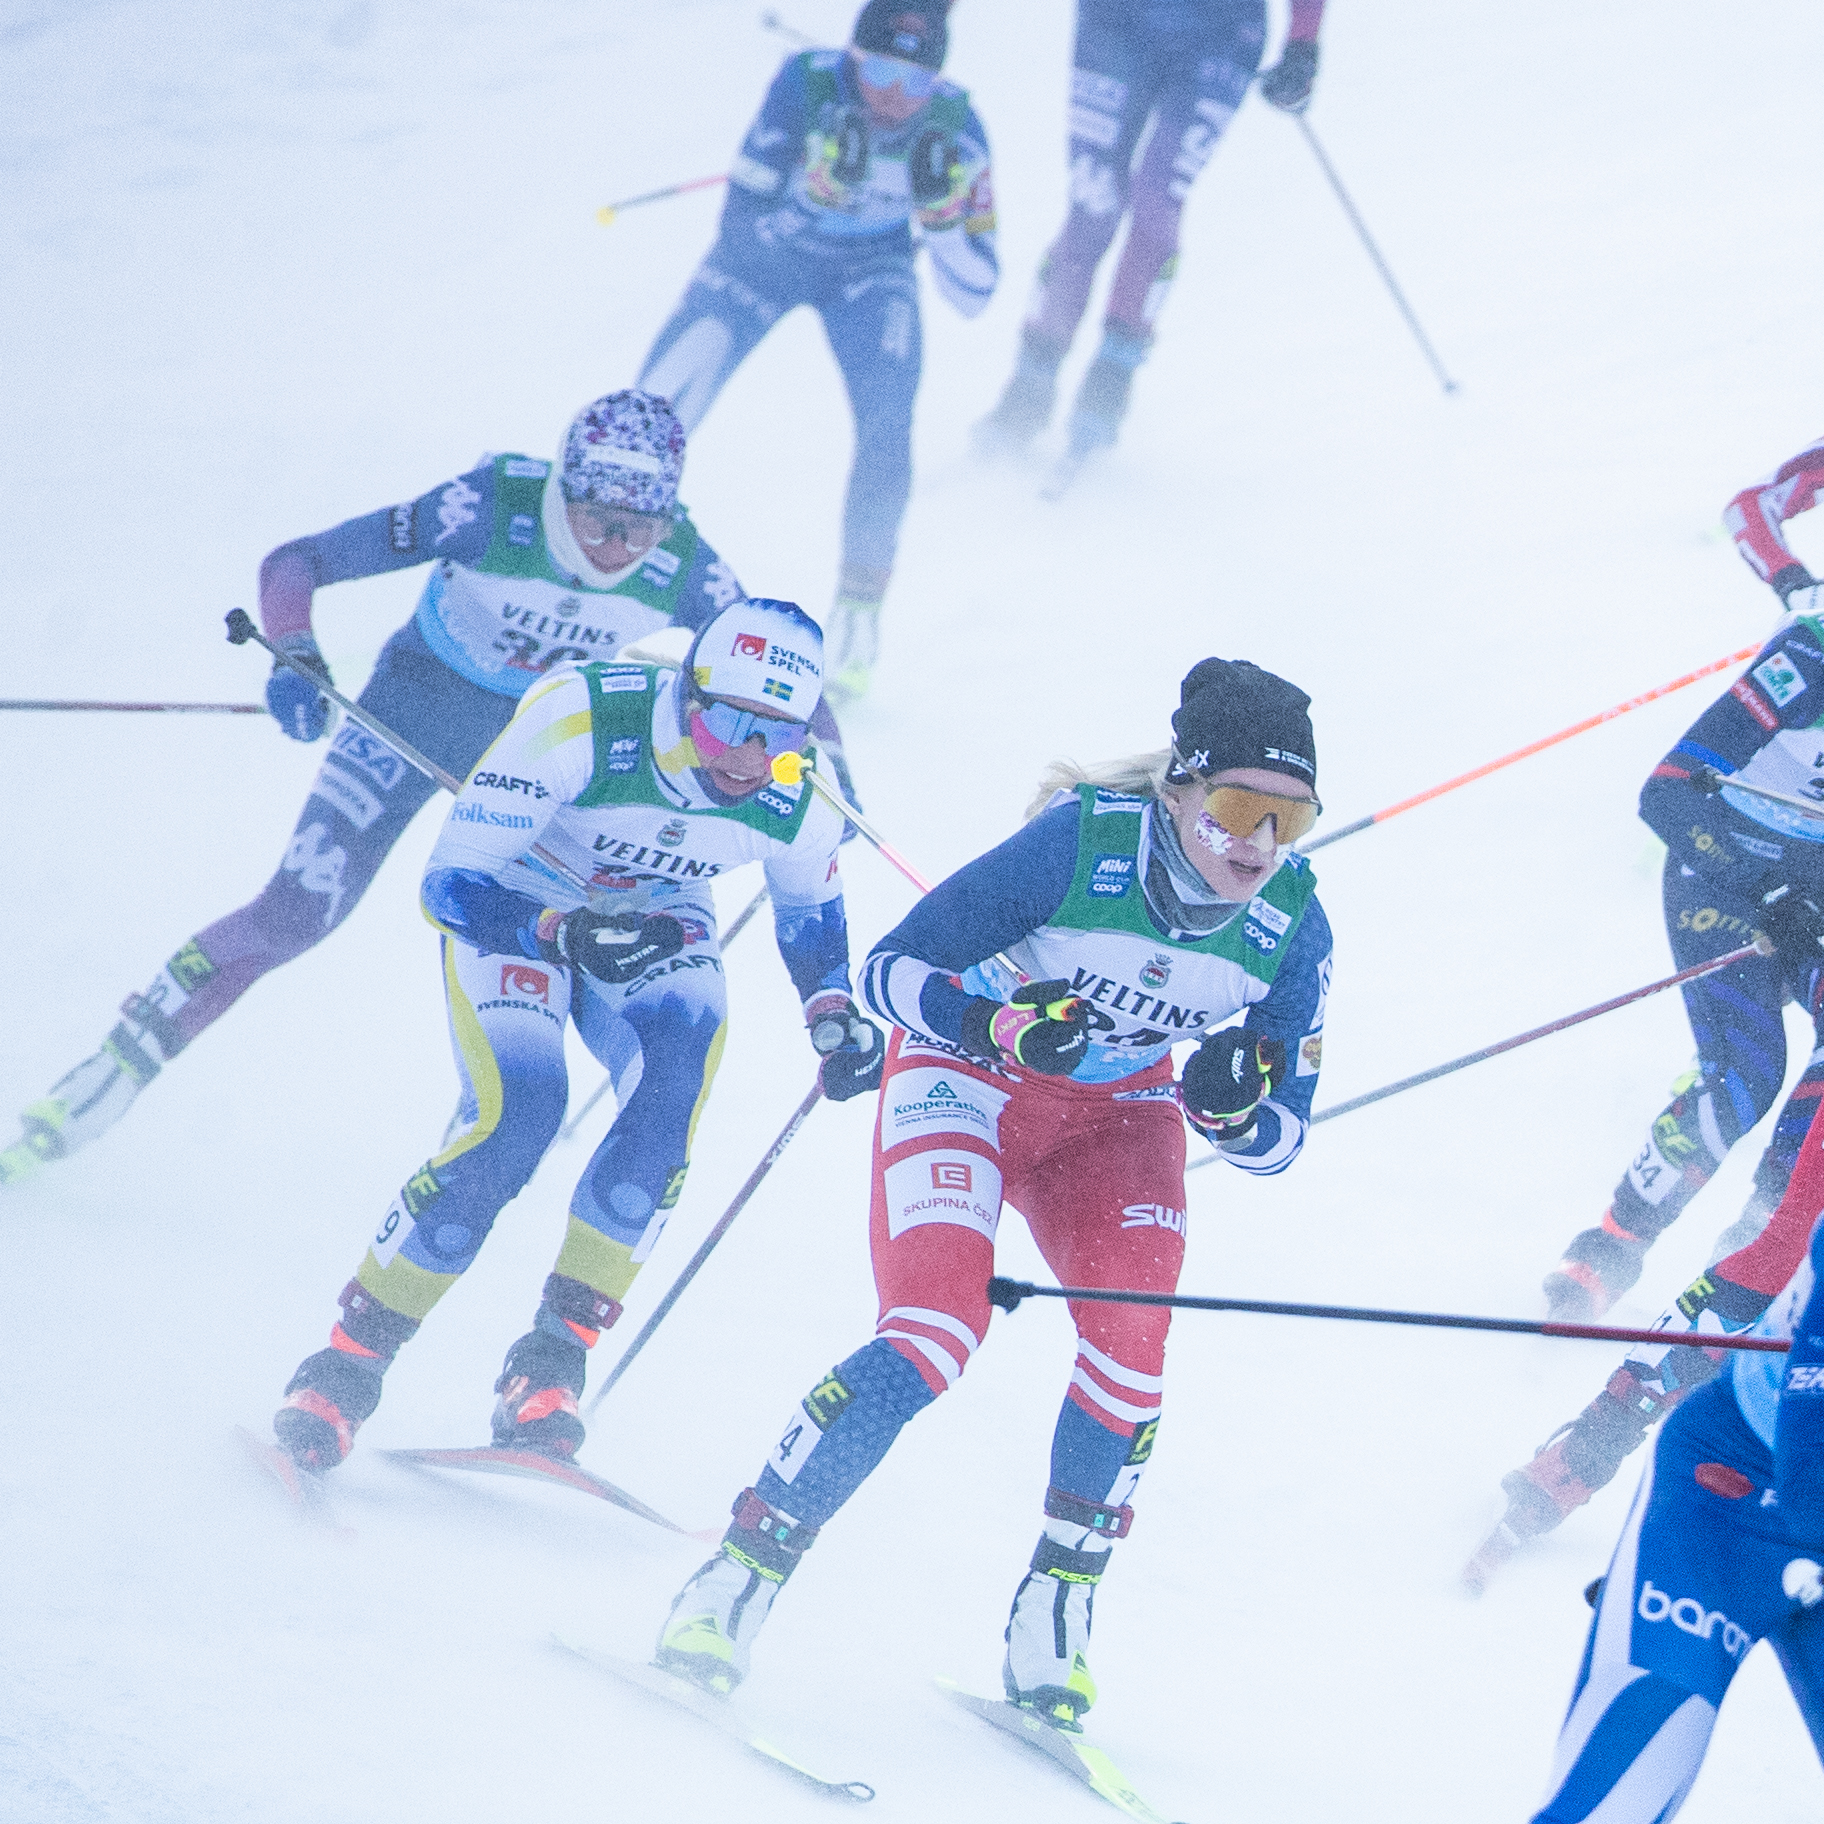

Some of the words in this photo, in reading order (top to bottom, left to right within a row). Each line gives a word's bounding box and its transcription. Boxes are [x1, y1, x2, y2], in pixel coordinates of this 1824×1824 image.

[502, 602, 619, 646] VELTINS
[768, 655, 802, 677] SPEL
[473, 771, 535, 796] CRAFT
[757, 790, 794, 815] coop
[593, 833, 723, 878] VELTINS
[1243, 921, 1278, 950] coop
[1069, 966, 1210, 1030] VELTINS
[903, 1197, 969, 1217] SKUPINA
